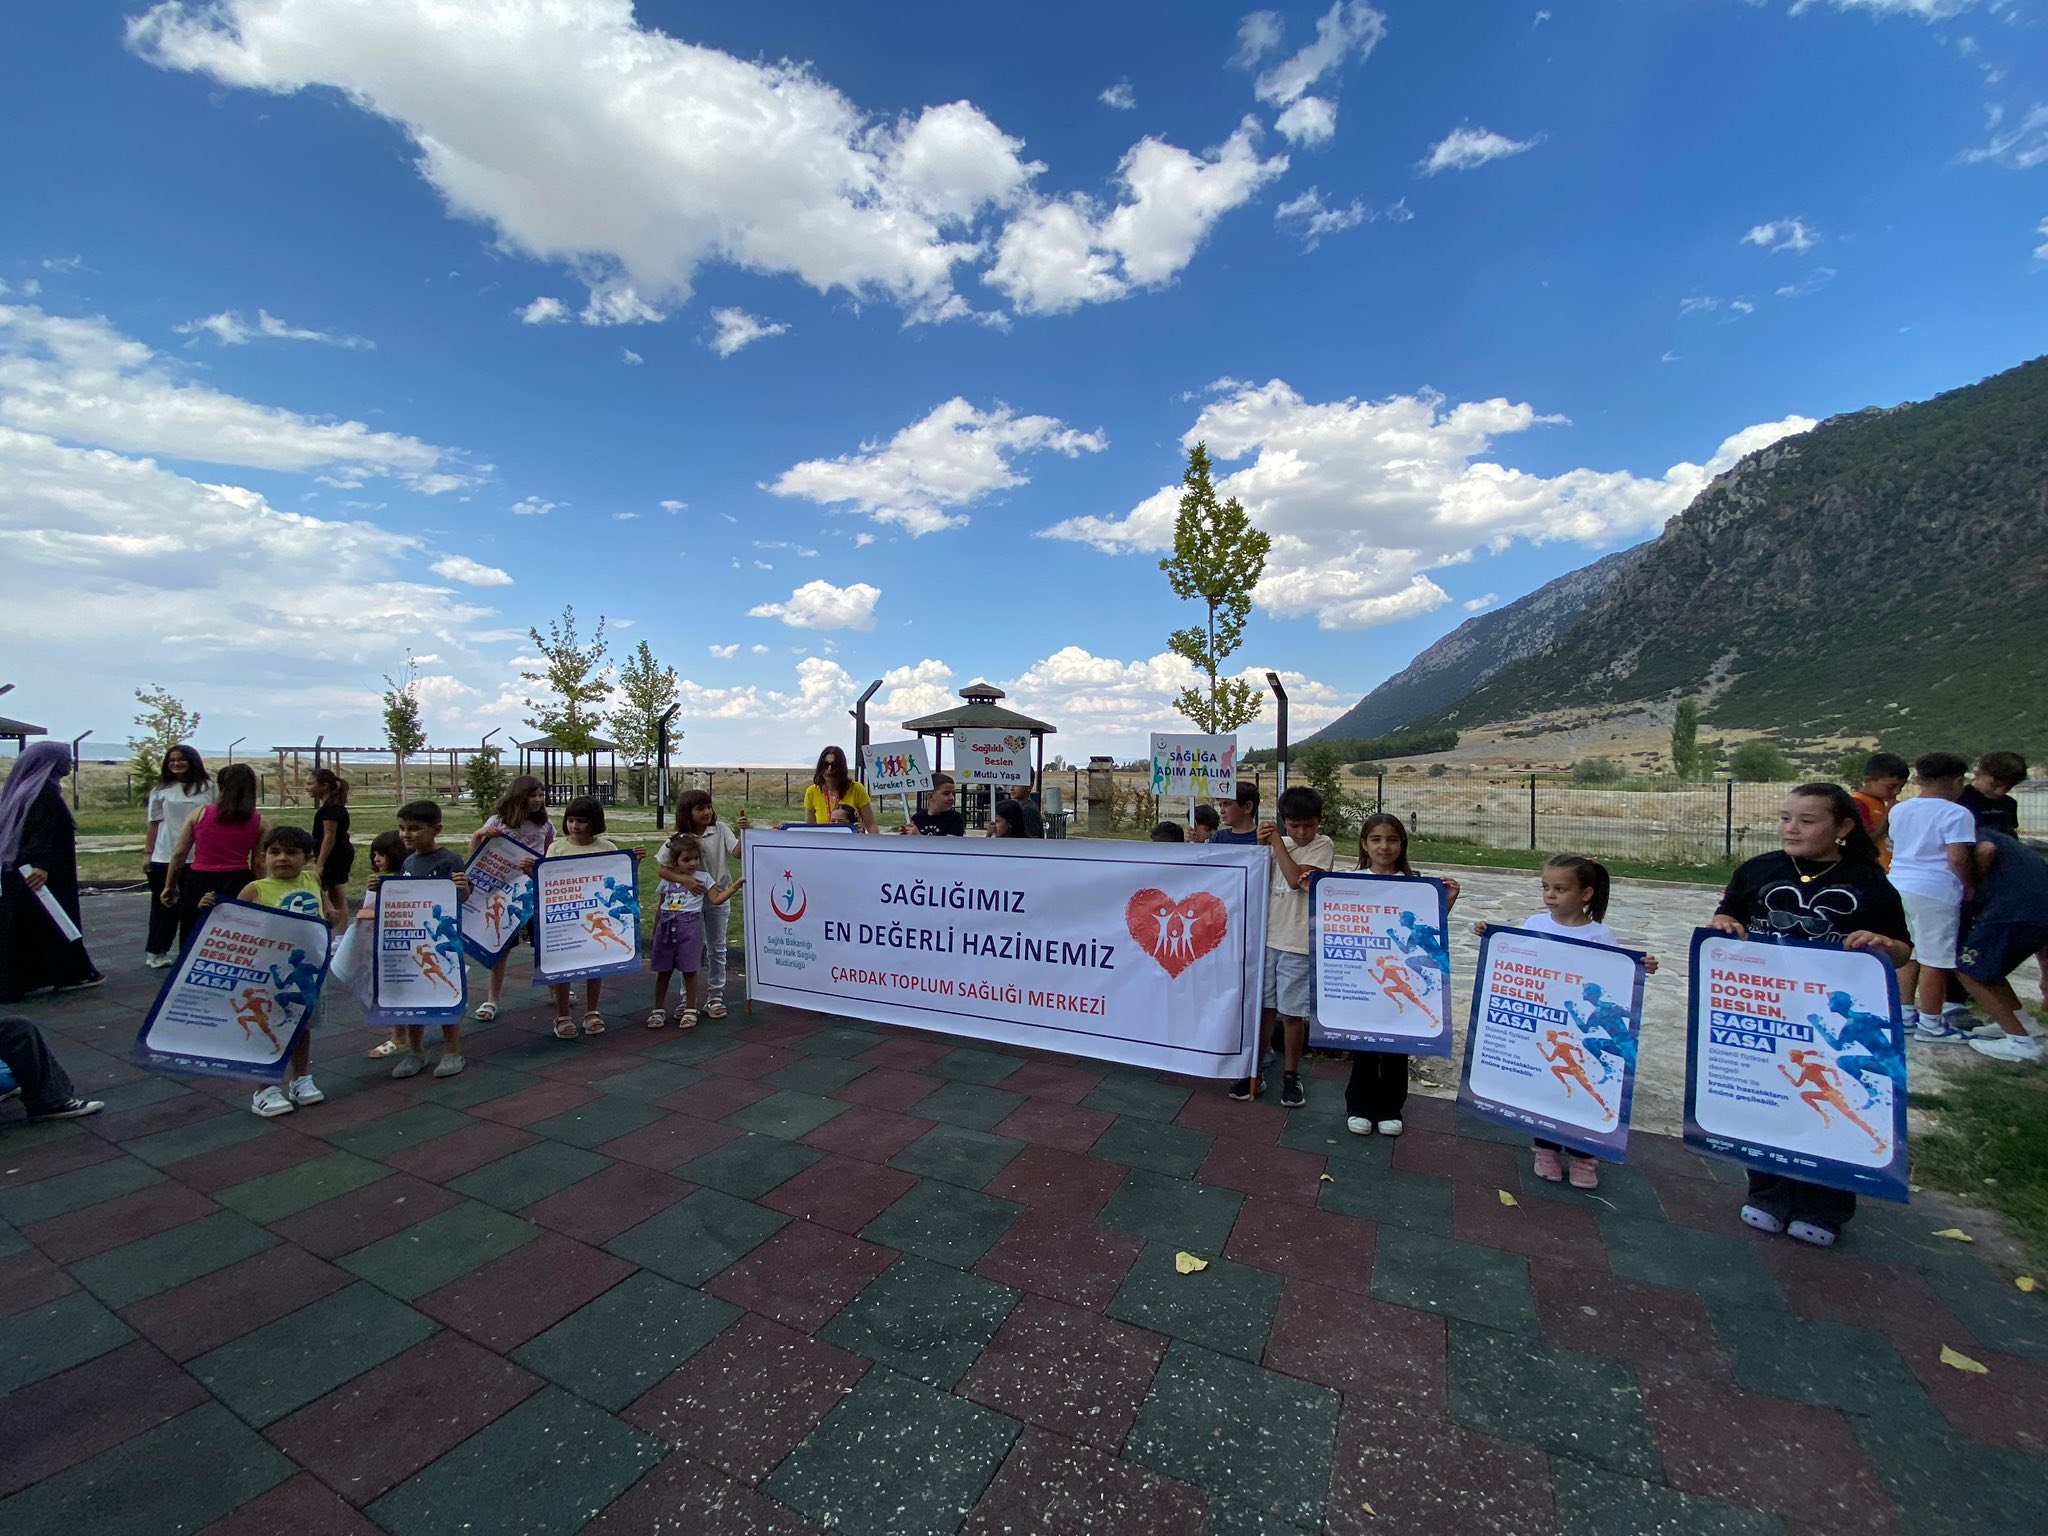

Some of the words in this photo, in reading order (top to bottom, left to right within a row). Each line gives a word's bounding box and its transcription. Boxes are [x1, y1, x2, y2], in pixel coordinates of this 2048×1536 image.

[972, 743, 1003, 755] Sağlıklı
[984, 757, 1013, 766] Beslen
[1170, 750, 1217, 762] SAĞLIĞA
[974, 770, 998, 779] Mutlu
[999, 770, 1020, 781] Yaşa
[1157, 766, 1186, 776] ADIM
[1189, 767, 1230, 778] ATALIM
[873, 779, 903, 790] Hareket
[906, 779, 915, 787] Et
[545, 876, 589, 888] HAREKET
[880, 879, 1025, 913] SAĞLIĞIMIZ
[1323, 902, 1381, 914] HAREKET
[1323, 923, 1374, 935] BESLEN,
[210, 927, 276, 949] HAREKET
[824, 920, 850, 943] EN
[859, 920, 953, 953] DEĞERLİ
[963, 931, 1115, 970] HAZİNEMİZ
[1494, 959, 1561, 981] HAREKET
[1711, 969, 1798, 991] HAREKET
[1803, 982, 1831, 998] ET,
[831, 966, 887, 987] ÇARDAK
[891, 973, 953, 996] TOPLUM
[958, 980, 1022, 1004] SAĞLIĞI
[1028, 990, 1106, 1015] MERKEZİ
[1491, 984, 1548, 1005] BESLEN,
[1711, 996, 1787, 1021] BESLEN,
